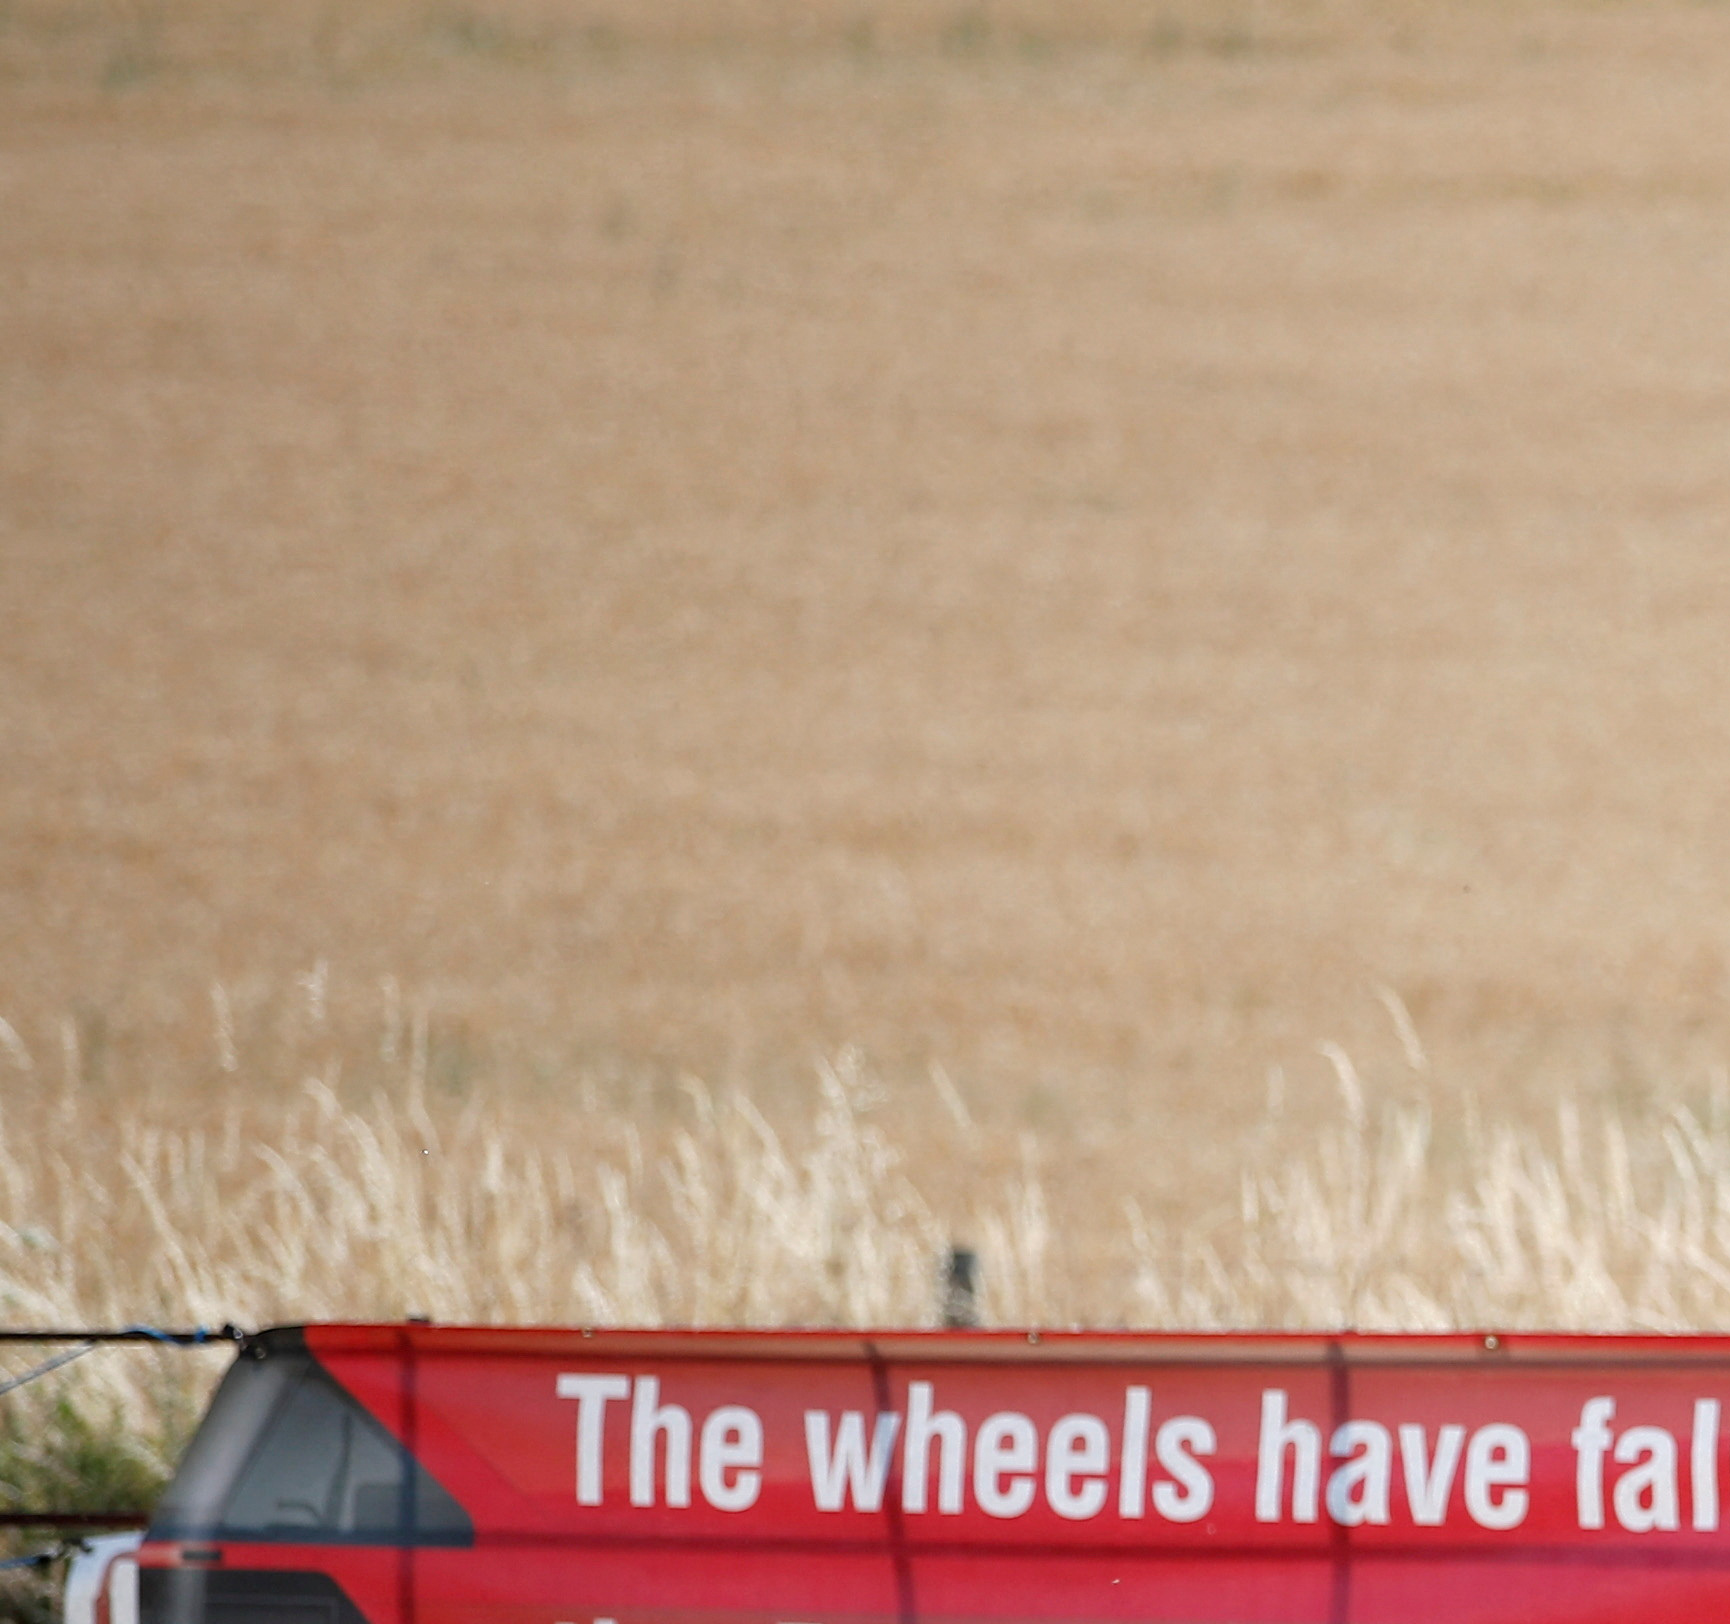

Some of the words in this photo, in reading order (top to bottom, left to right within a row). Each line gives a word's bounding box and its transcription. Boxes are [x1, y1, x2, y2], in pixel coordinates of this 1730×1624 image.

[557, 1374, 764, 1511] The
[804, 1382, 1217, 1522] wheels
[1255, 1389, 1530, 1529] have
